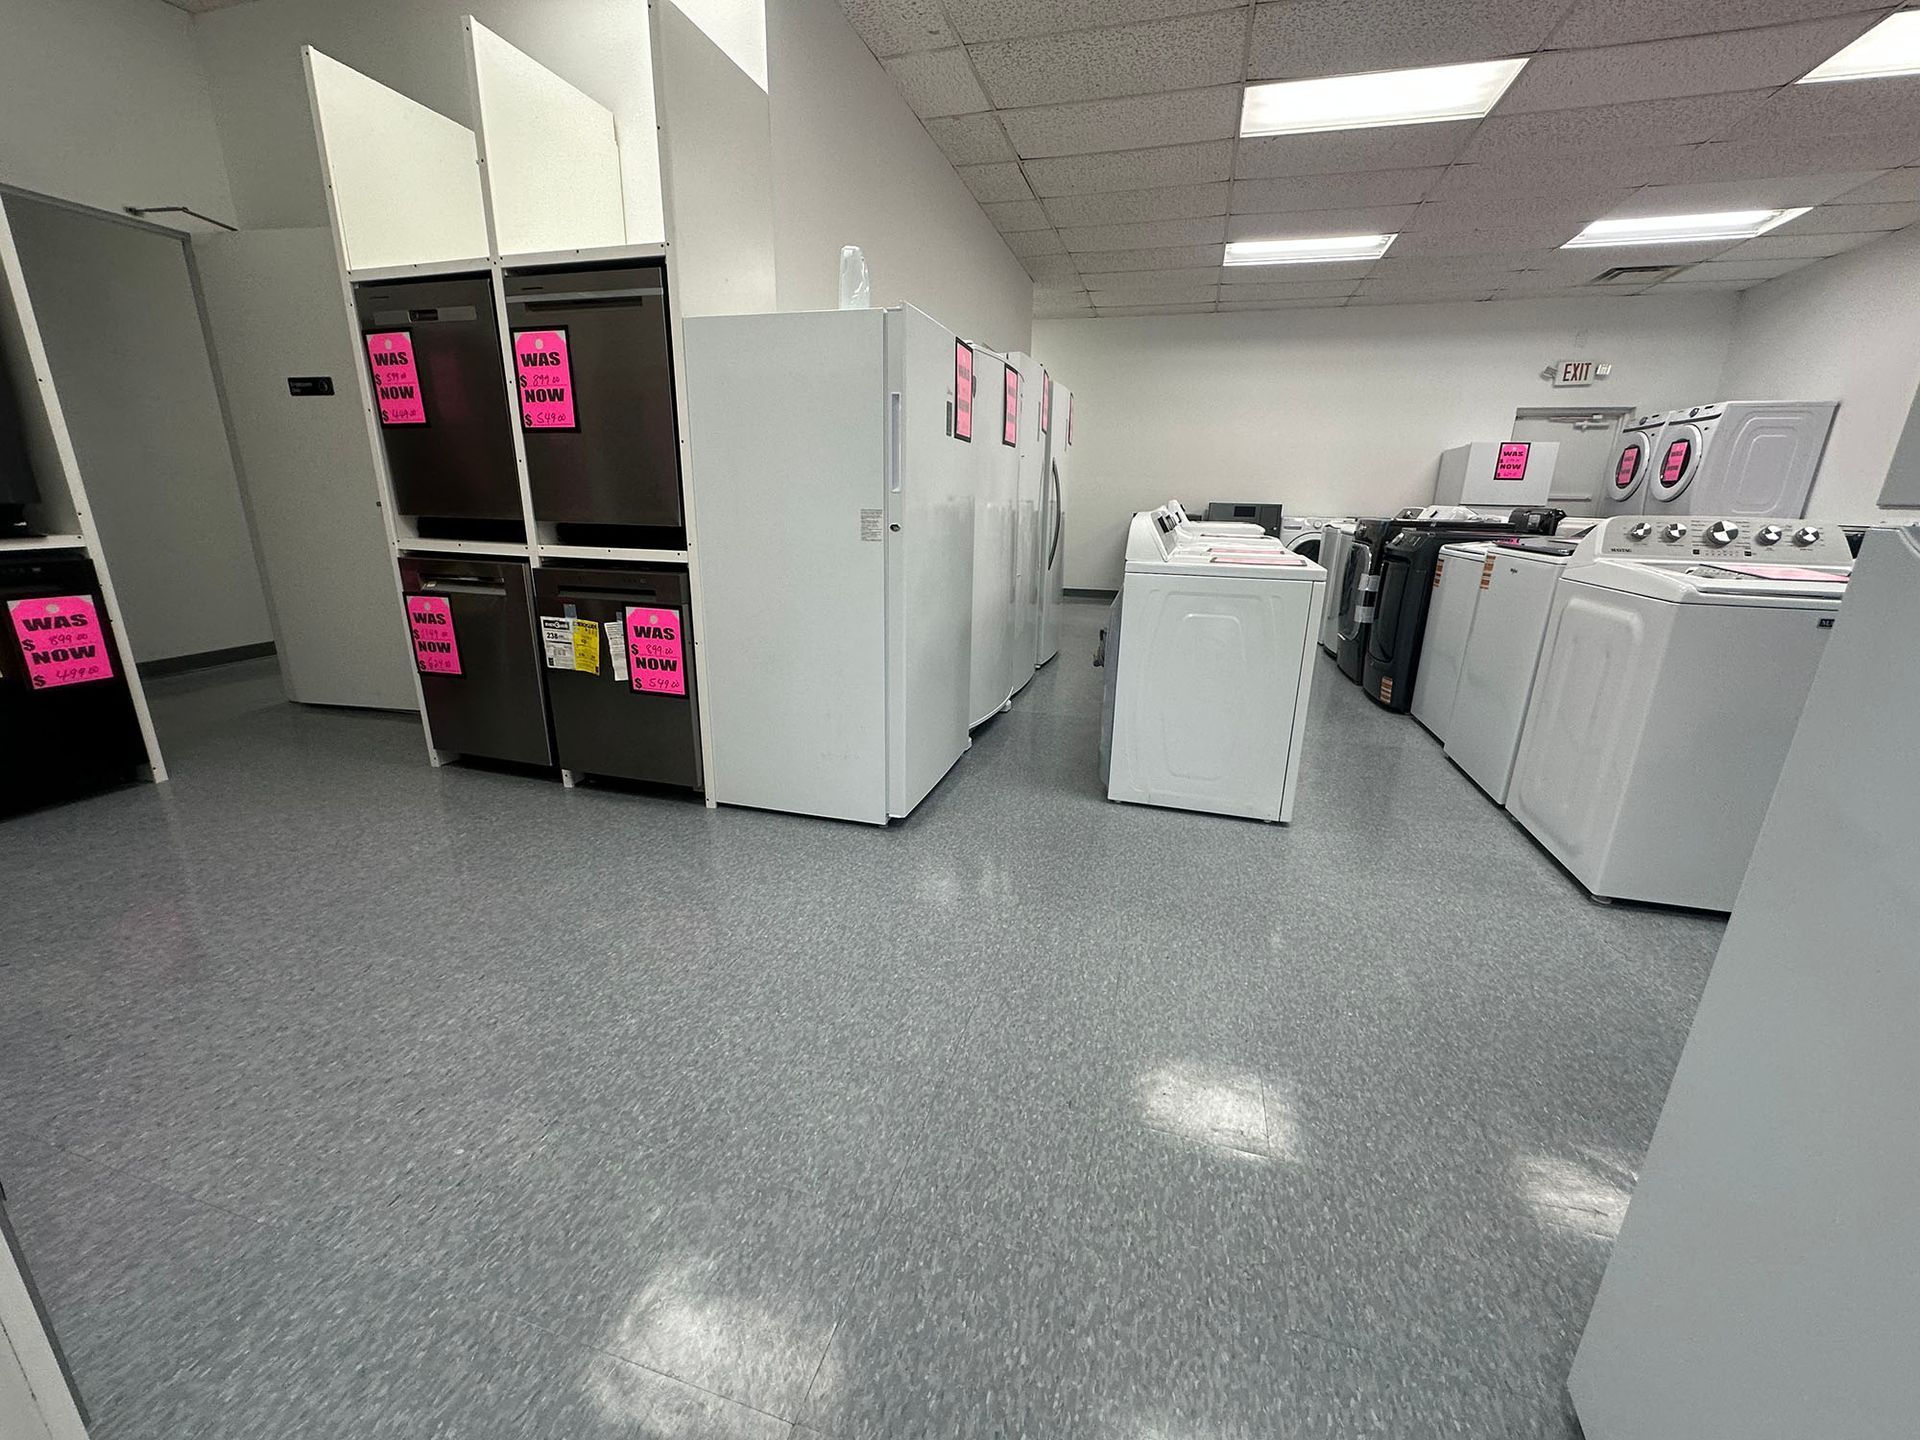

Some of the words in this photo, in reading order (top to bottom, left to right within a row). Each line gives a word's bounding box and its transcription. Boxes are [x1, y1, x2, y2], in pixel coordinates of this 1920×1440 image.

[373, 352, 409, 366] WAS
[520, 352, 561, 367] WAS
[1562, 362, 1592, 382] EXIT
[520, 374, 528, 388] $
[380, 386, 415, 400] NOW
[524, 388, 565, 403] NOW
[524, 413, 533, 427] $
[22, 613, 89, 632] WAS
[412, 612, 447, 626] WAS
[633, 625, 676, 641] WAS
[22, 639, 36, 652] $
[417, 640, 451, 654] NOW
[631, 643, 640, 656] $
[31, 645, 96, 665] NOW
[635, 656, 678, 672] NOW
[33, 674, 46, 687] $
[634, 677, 643, 689] $
